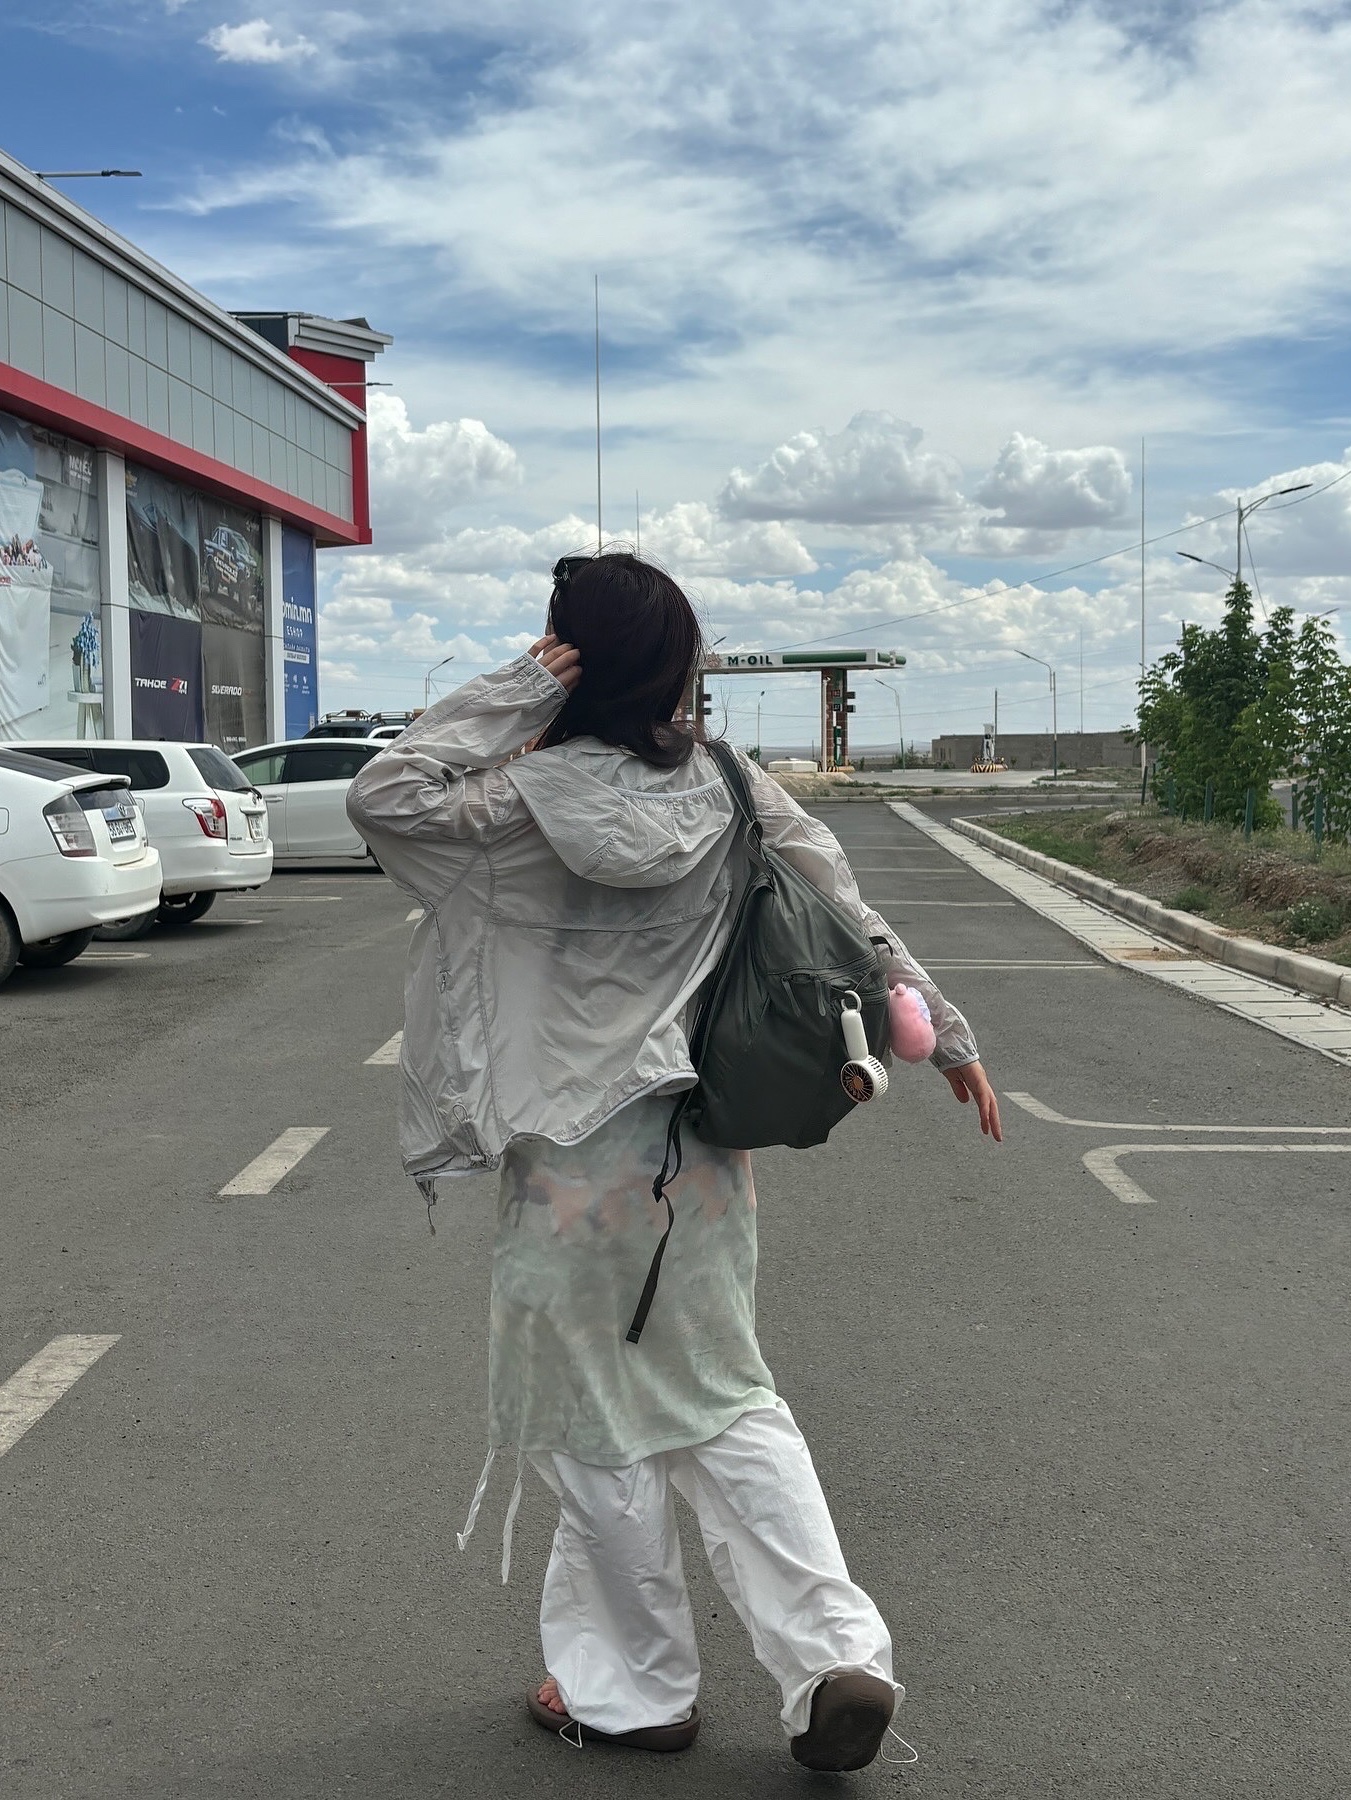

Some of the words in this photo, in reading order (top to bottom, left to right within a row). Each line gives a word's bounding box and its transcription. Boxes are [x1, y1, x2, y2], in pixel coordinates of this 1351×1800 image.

[727, 655, 773, 666] M-OIL
[134, 677, 167, 689] TAHOE
[211, 684, 242, 696] SILVERADO
